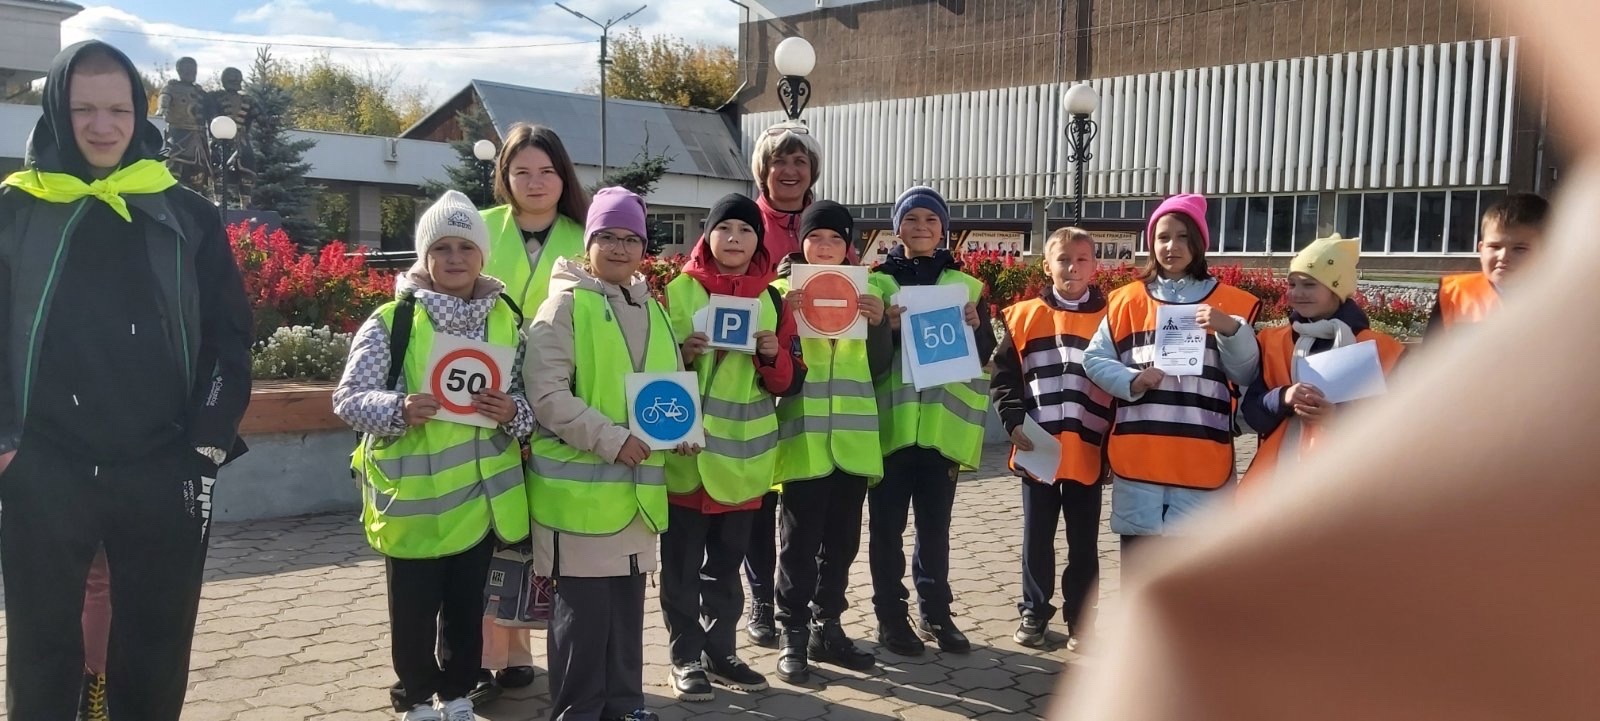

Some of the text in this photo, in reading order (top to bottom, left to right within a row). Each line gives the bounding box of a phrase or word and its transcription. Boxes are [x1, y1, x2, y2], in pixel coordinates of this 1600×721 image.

[721, 313, 742, 339] P
[924, 322, 956, 348] 50
[446, 368, 487, 395] 50
